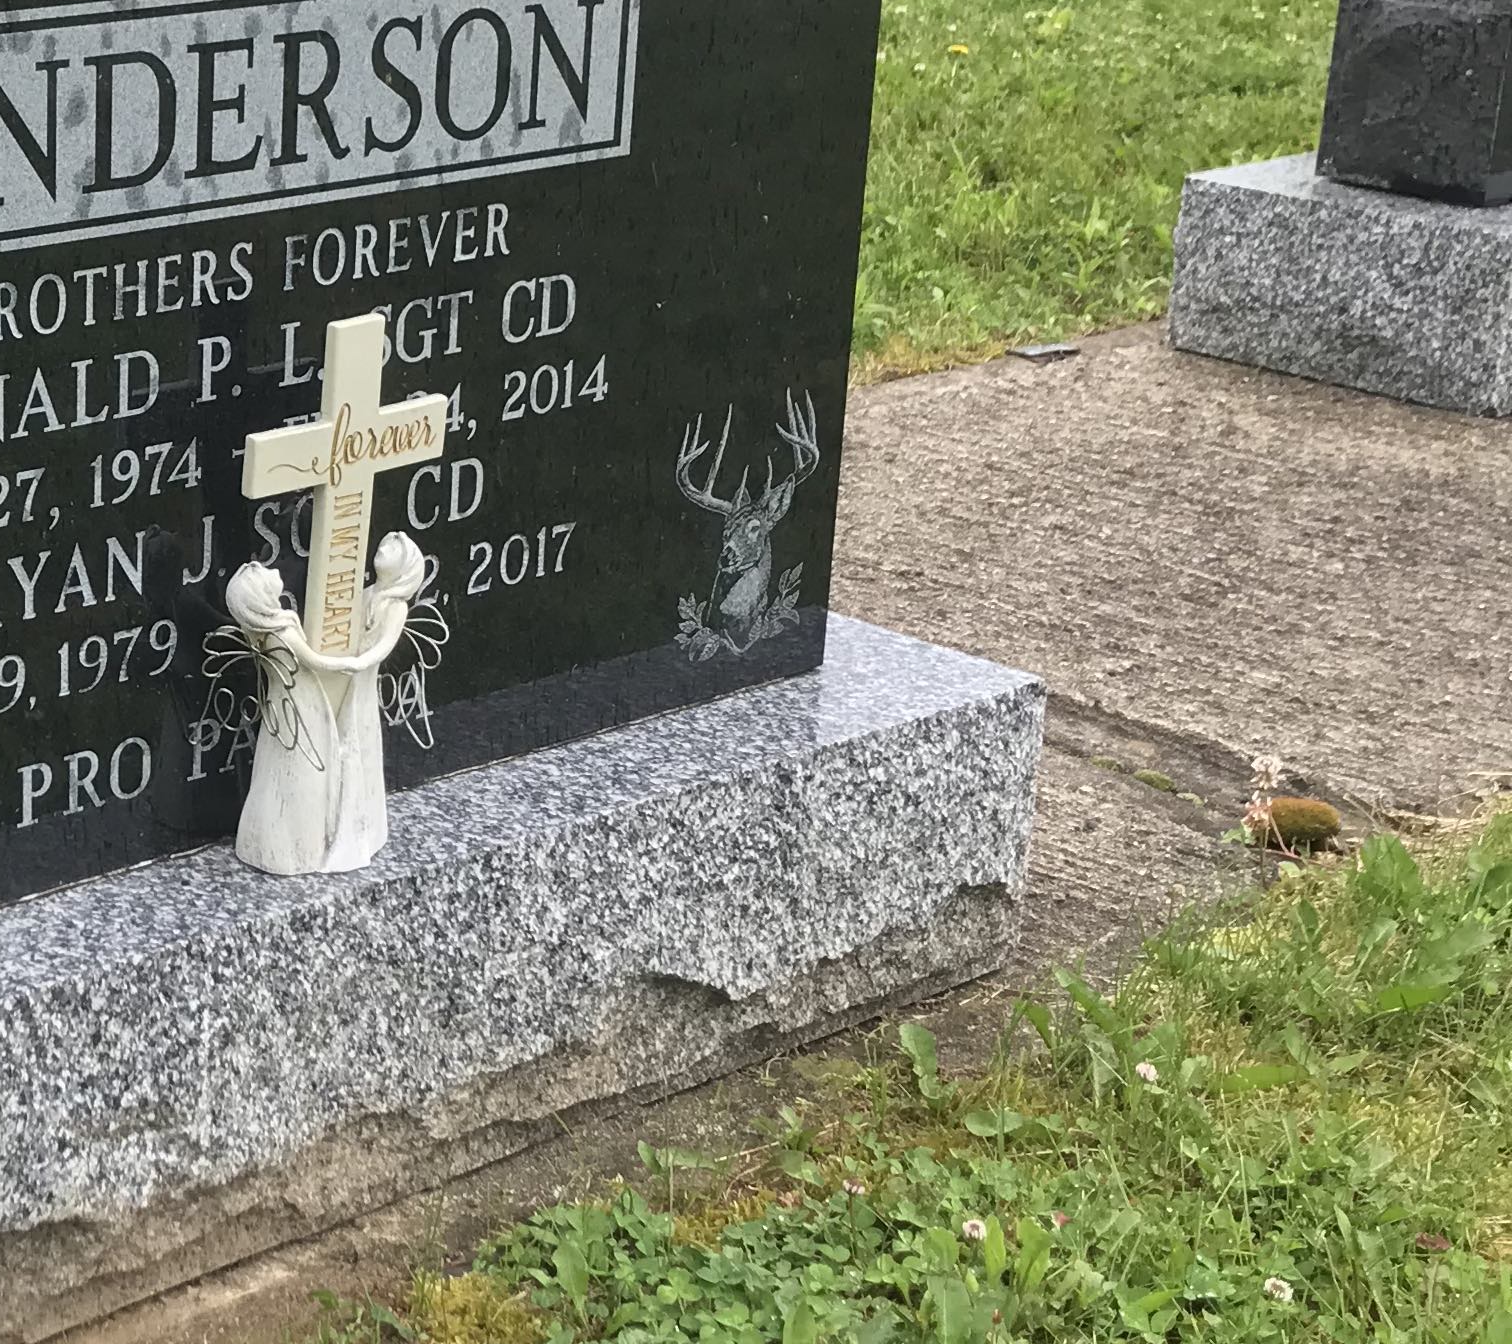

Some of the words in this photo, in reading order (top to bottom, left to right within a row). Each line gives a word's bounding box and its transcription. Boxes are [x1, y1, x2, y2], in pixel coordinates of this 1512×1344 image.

[282, 202, 510, 292] FOREVER
[195, 335, 242, 404] P.
[501, 273, 577, 344] CD
[89, 439, 203, 509] 1974
[500, 353, 609, 422] 2014
[311, 401, 437, 487] forever
[181, 514, 227, 586] J.
[406, 457, 485, 530] CD
[329, 522, 361, 563] MY
[334, 490, 364, 521] IN
[57, 618, 179, 698] 1979
[466, 520, 578, 596] 2017
[319, 567, 356, 652] HEART
[16, 735, 152, 829] PRO
